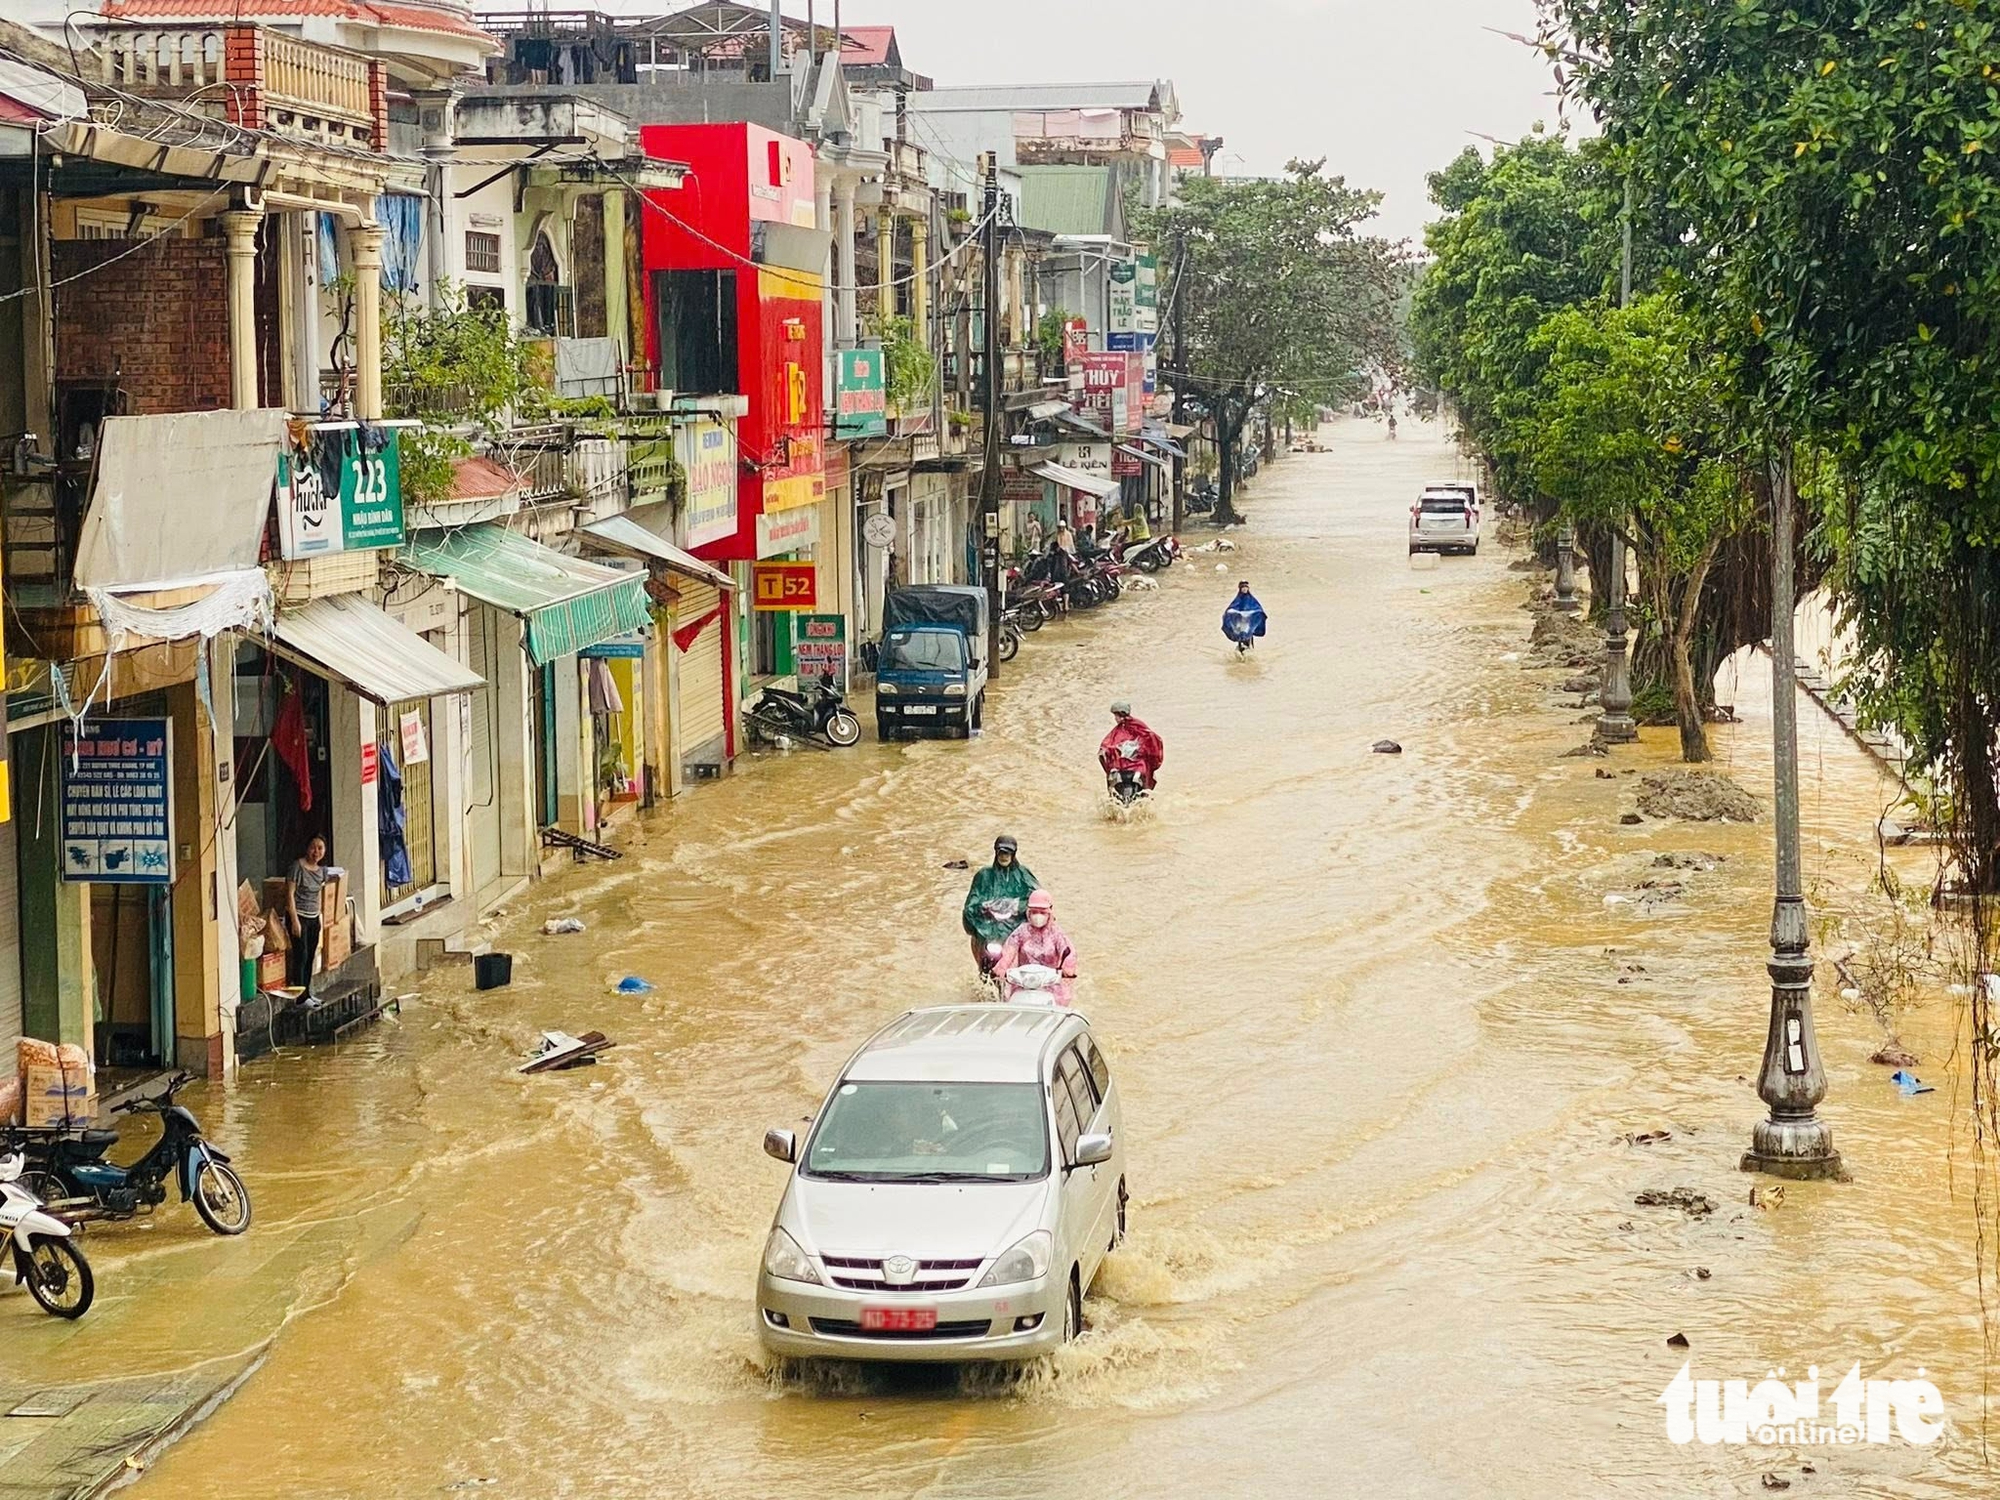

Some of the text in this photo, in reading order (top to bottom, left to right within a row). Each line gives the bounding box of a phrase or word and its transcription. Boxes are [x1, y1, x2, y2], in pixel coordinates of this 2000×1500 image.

[351, 459, 387, 504] 223
[764, 578, 810, 595] T 52
